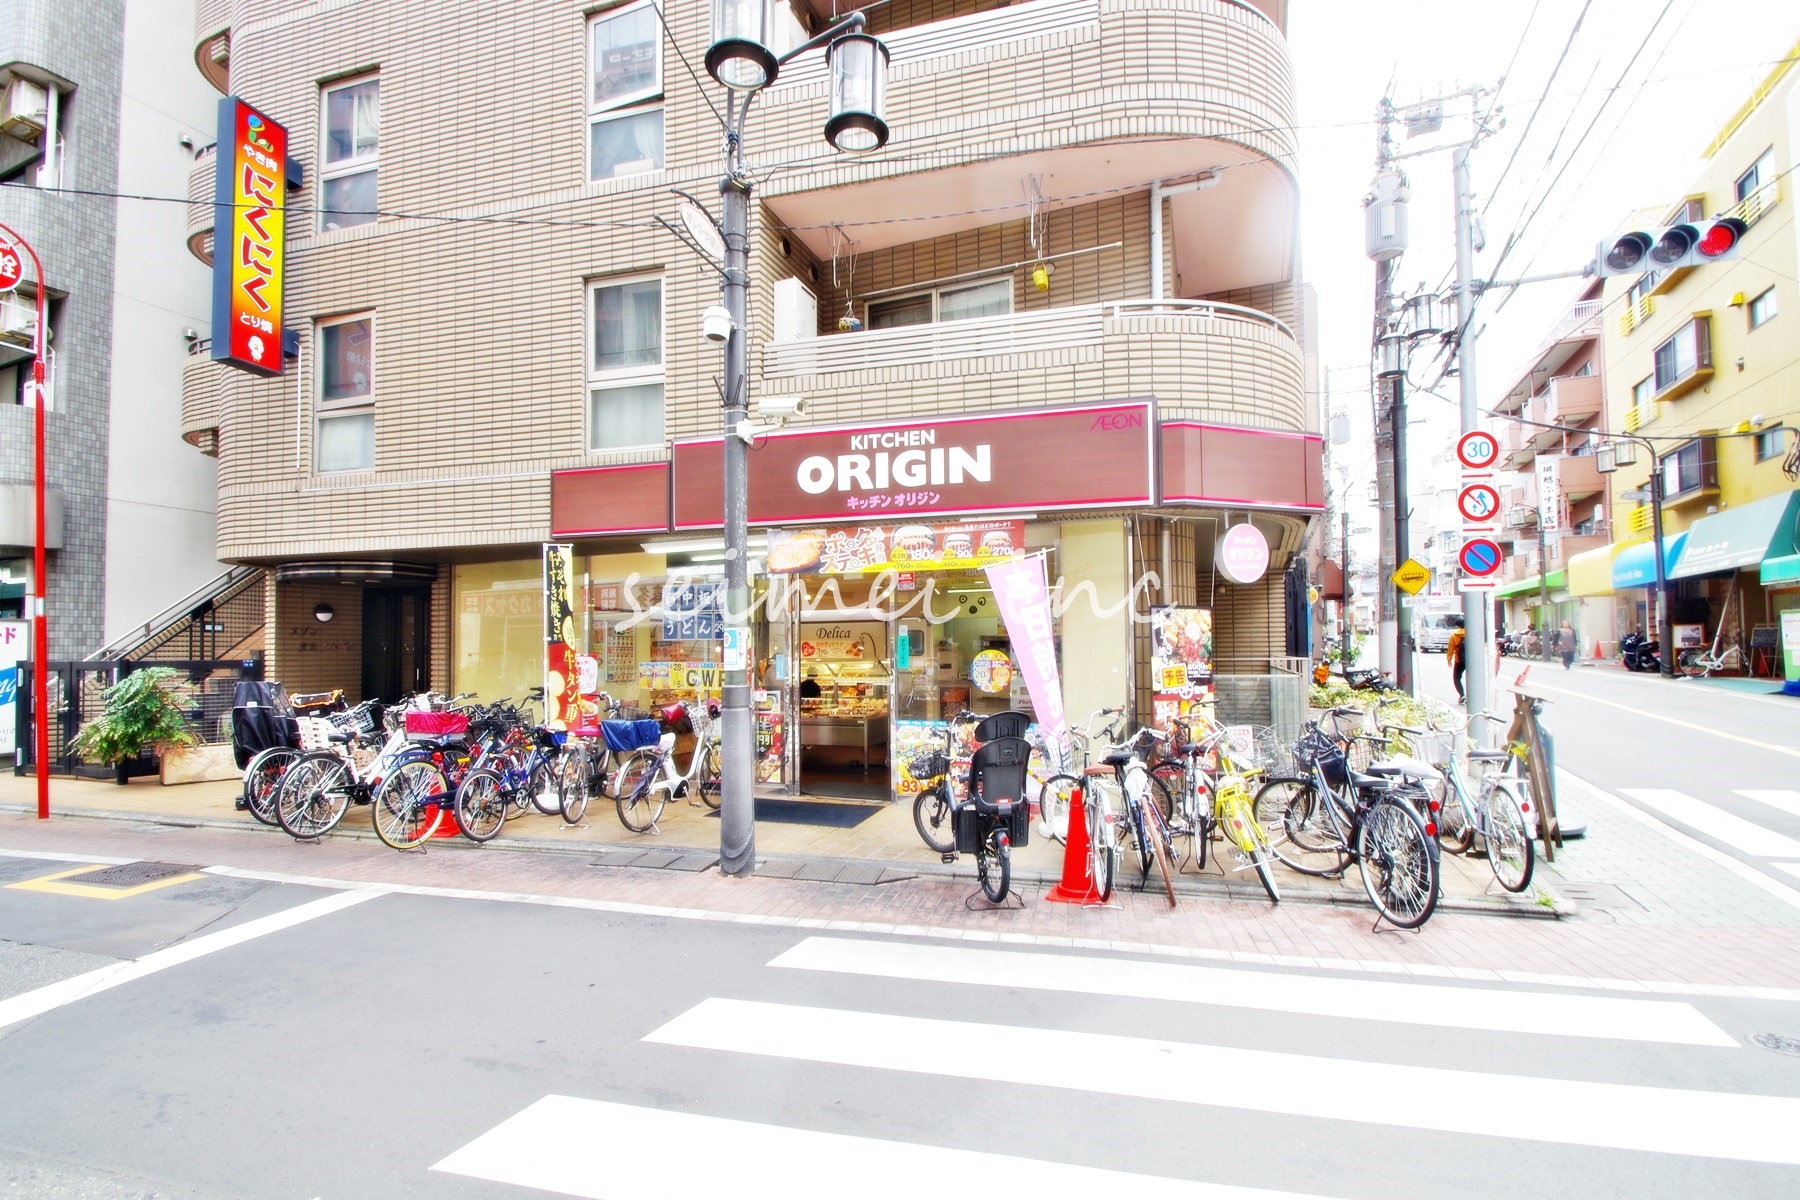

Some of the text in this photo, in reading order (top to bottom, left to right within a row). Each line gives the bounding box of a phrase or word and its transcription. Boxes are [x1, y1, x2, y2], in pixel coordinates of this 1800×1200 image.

[242, 143, 278, 173] やき肉
[240, 161, 277, 313] にくにく
[240, 311, 273, 335] とり焼
[851, 429, 935, 450] KITCHEN
[1467, 441, 1490, 458] 30
[796, 444, 991, 494] ORIGIN
[847, 491, 941, 510] キッチン オリジン
[667, 619, 711, 635] うどん
[816, 625, 851, 639] Delica
[563, 650, 578, 723] 牛タン重
[1164, 669, 1185, 686] 予告
